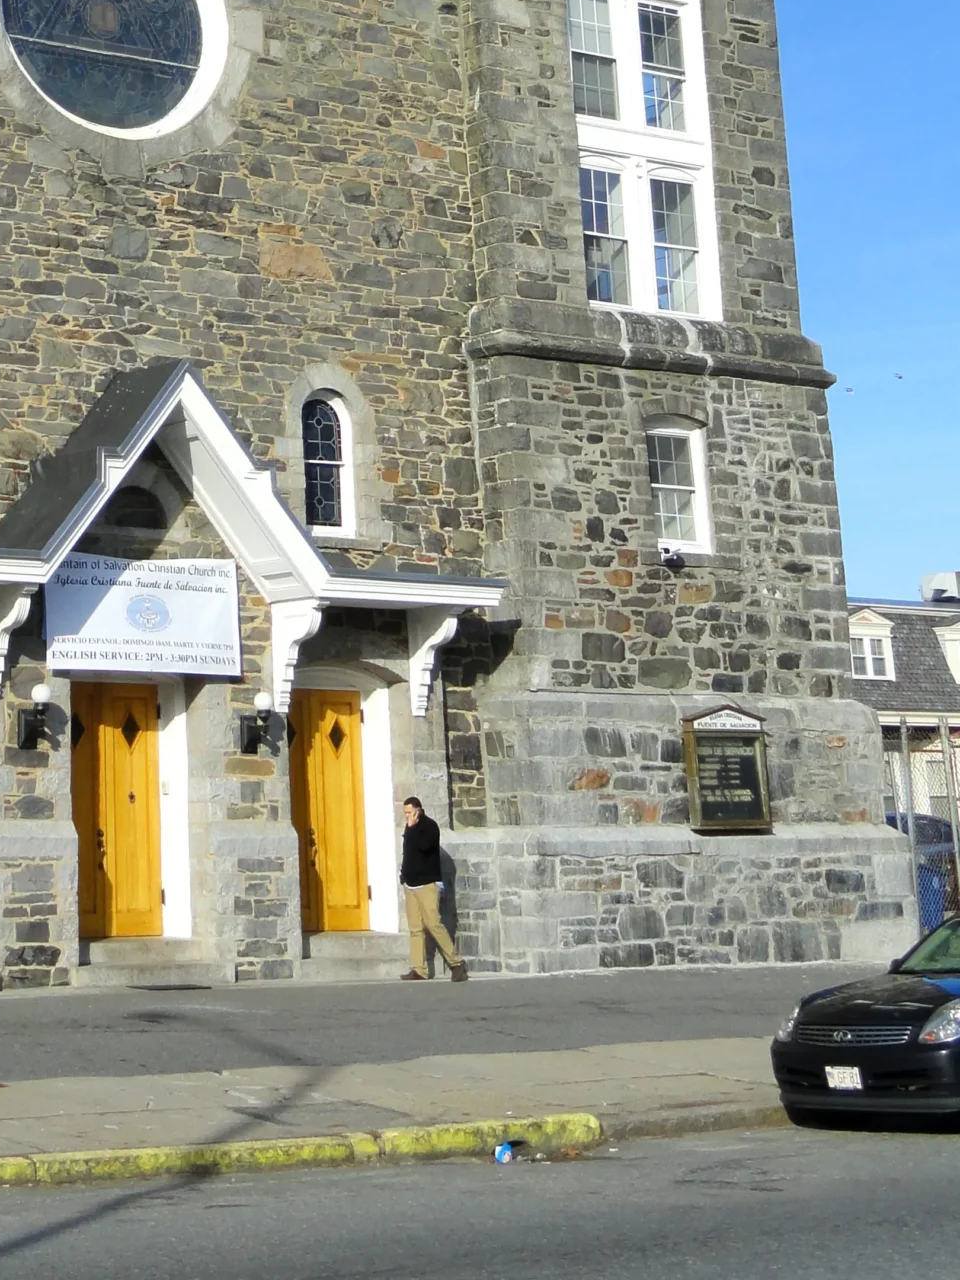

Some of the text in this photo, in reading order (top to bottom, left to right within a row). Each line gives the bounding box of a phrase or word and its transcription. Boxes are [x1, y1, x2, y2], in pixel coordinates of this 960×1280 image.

[91, 559, 100, 570] of
[103, 560, 145, 572] Salvation
[148, 562, 185, 575] Christian
[188, 564, 216, 577] Church
[218, 569, 233, 579] inc.
[54, 574, 228, 594] Iglesia Cristiana Fuente de Salvacion inc.
[53, 636, 87, 644] SERVICIO
[122, 638, 154, 646] DOMINGO
[173, 641, 194, 649] MARTE
[195, 641, 200, 649] Y
[52, 650, 97, 660] ENGLISH
[99, 651, 143, 661] SERVICE:
[145, 652, 163, 661] 2PM
[170, 653, 198, 663] 3:30PM
[200, 655, 236, 665] SUNDAYS
